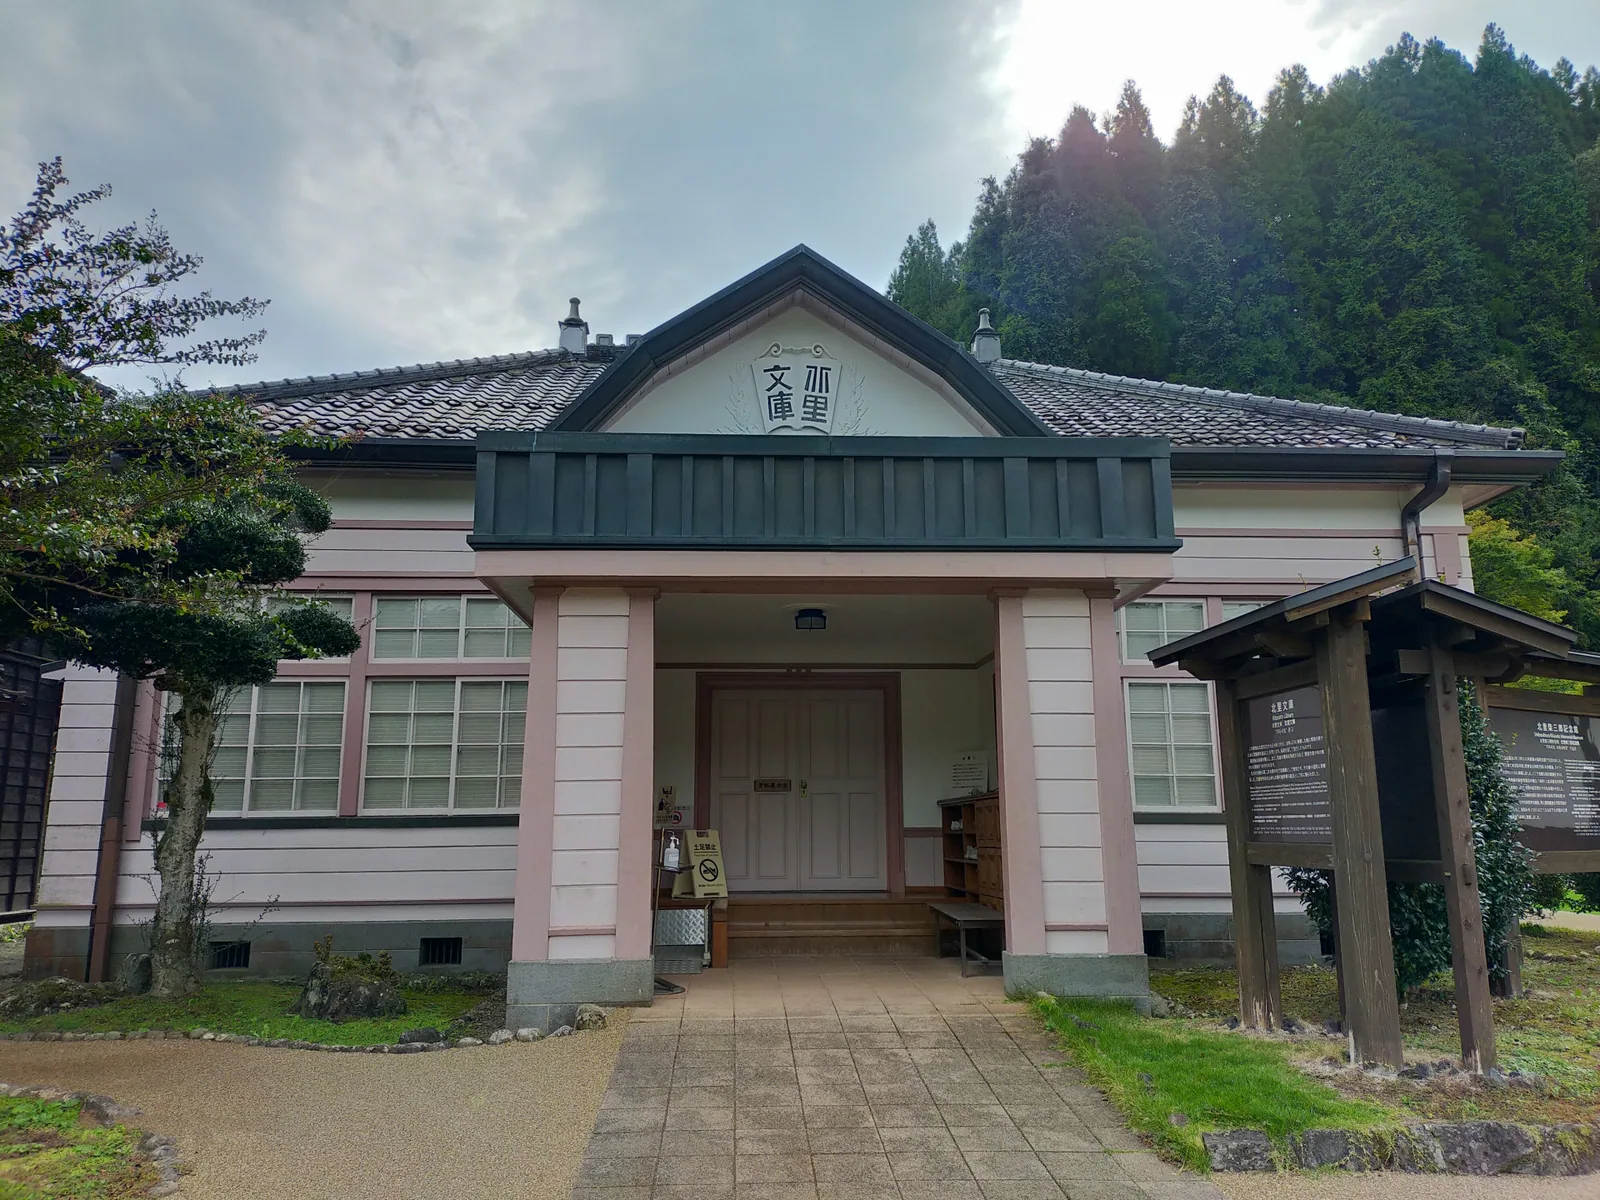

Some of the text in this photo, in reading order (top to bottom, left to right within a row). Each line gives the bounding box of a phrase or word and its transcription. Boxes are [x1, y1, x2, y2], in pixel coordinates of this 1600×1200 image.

[763, 364, 795, 422] 文庫
[693, 843, 717, 851] 土足禁止
